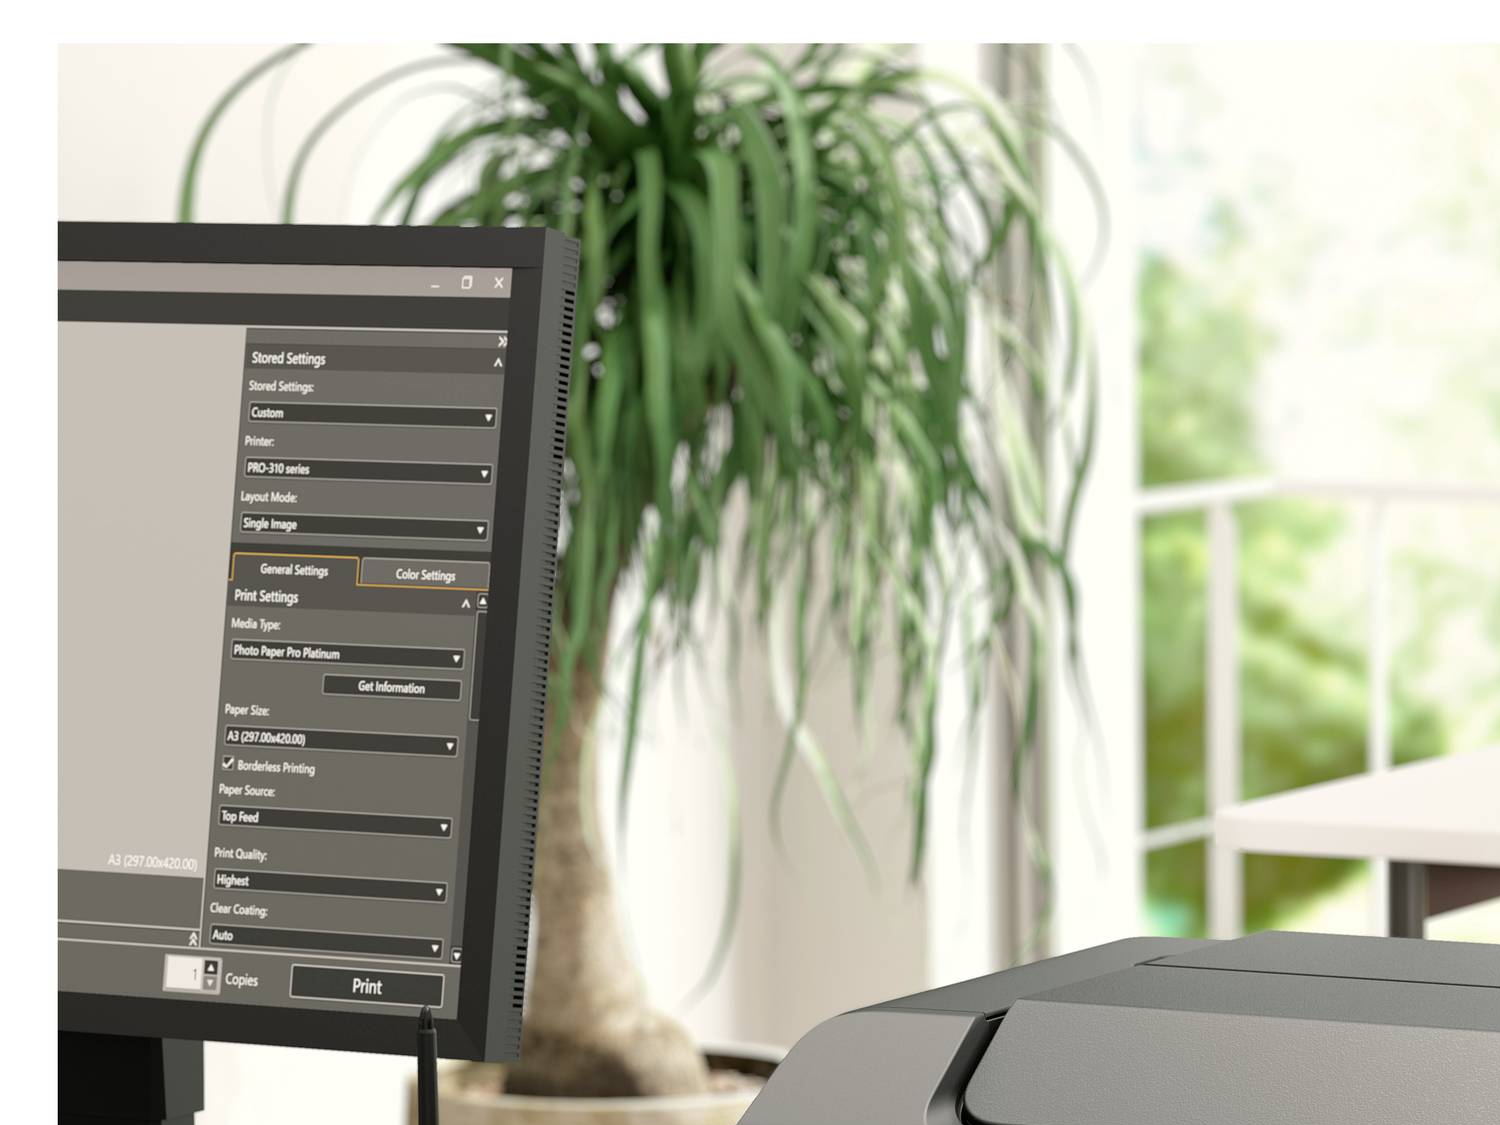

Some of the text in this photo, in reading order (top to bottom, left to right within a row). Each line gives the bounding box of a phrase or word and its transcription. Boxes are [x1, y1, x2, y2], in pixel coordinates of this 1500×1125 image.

[252, 352, 326, 368] Stored Settings
[249, 380, 314, 394] Stored Settings:
[251, 407, 284, 419] Custom
[244, 436, 275, 447] Printer:
[248, 462, 310, 475] PRO-310 series
[241, 491, 298, 504] Layout Mode:
[242, 517, 298, 532] Single Image
[260, 563, 328, 578] General Settings
[396, 568, 456, 582] Color Settings
[234, 589, 299, 606] Print Settings
[231, 617, 281, 633] Media Type:
[234, 645, 340, 660] Photo Paper Pro Platinum
[358, 680, 425, 695] Get Information
[225, 703, 270, 717] Paper Size:
[227, 730, 306, 747] A3 (297.00x420.00)
[238, 760, 315, 777] Borderless Printing
[219, 784, 276, 798] Paper Source:
[221, 810, 259, 825] Top Feed
[214, 847, 268, 862] Print Quality:
[108, 854, 198, 873] A3 (297.00x420.00)
[216, 874, 250, 889] Highest
[210, 902, 268, 920] Clear Coating:
[212, 929, 234, 942] Auto
[192, 967, 259, 989] 1 Copies
[352, 978, 383, 995] Print
